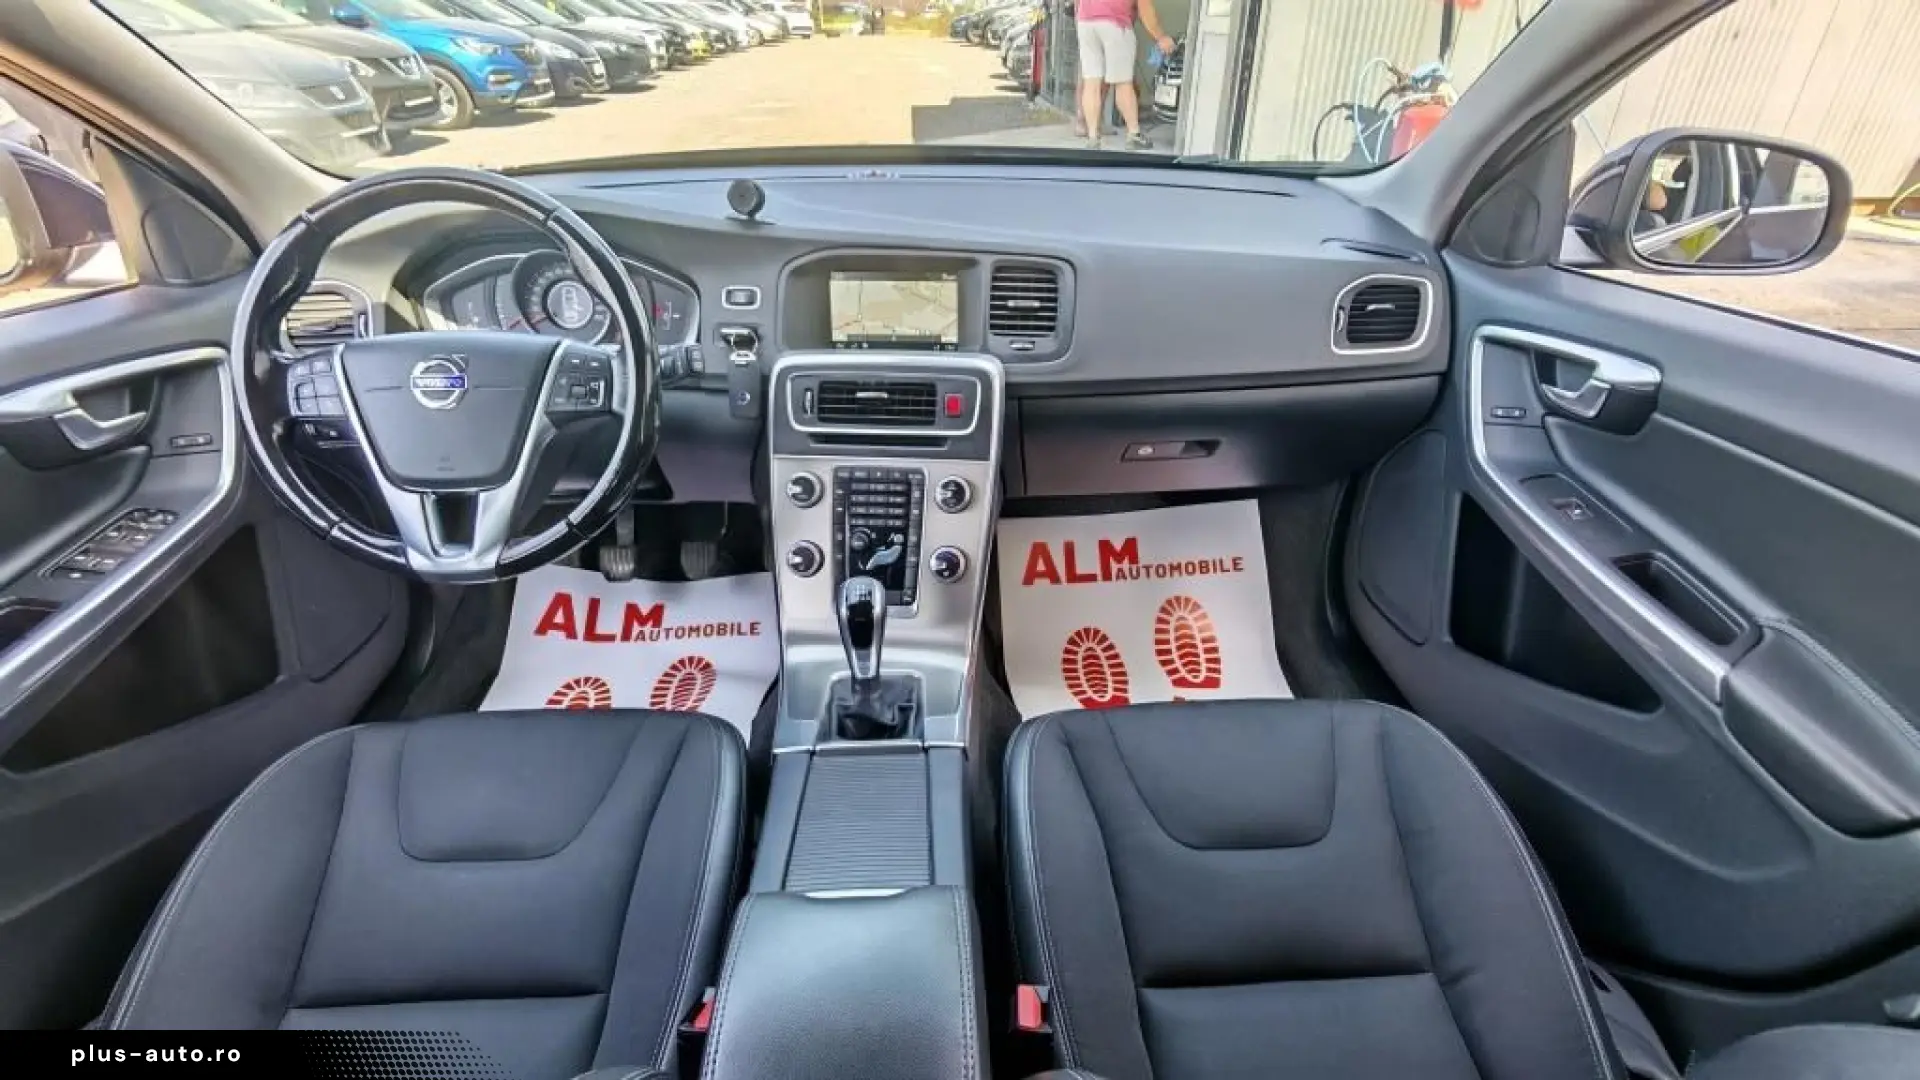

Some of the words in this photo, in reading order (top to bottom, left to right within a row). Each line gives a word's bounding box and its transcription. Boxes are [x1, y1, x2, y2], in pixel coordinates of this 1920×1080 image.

[1021, 536, 1139, 585] ALM
[1115, 556, 1244, 581] AUTOMOBILE
[533, 592, 665, 643] ALM
[633, 621, 761, 642] AUTOMOBILE
